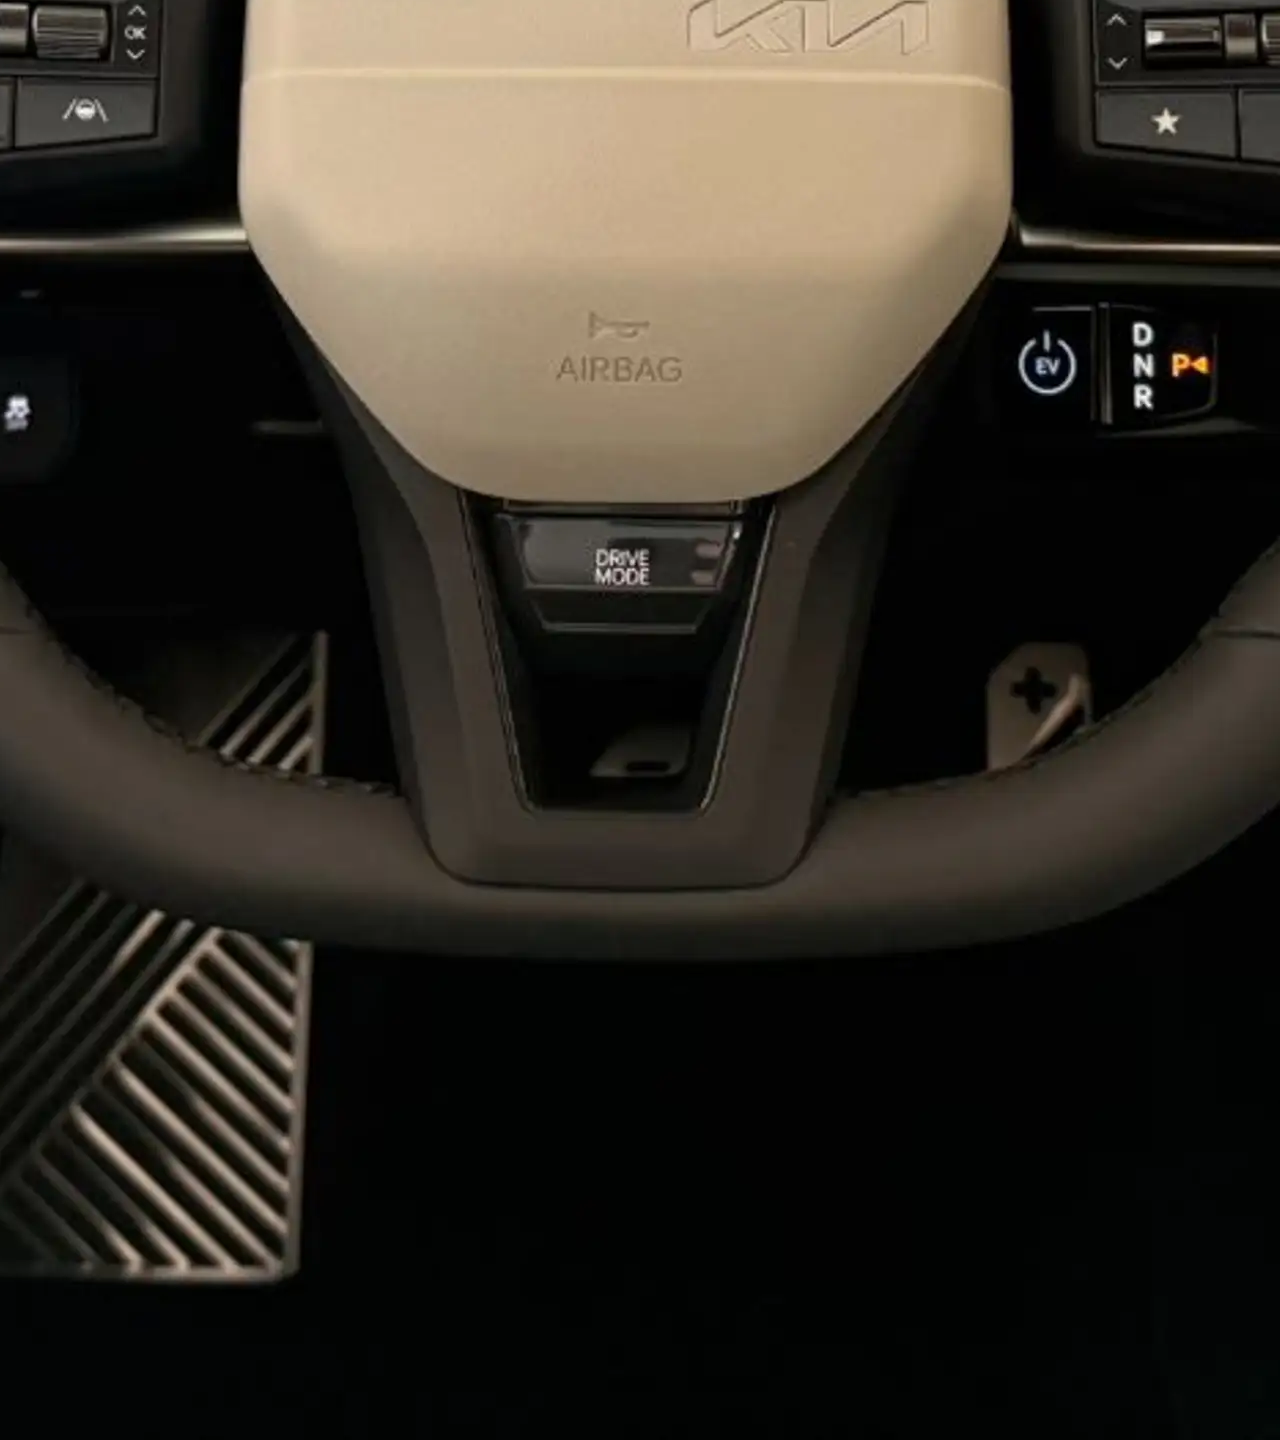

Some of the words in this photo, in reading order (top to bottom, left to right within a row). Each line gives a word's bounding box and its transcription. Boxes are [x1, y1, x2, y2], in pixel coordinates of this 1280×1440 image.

[124, 25, 146, 40] OK
[1132, 321, 1154, 347] D
[556, 356, 683, 384] AIRBAG
[1035, 356, 1061, 376] EV
[1133, 353, 1155, 378] N
[1171, 354, 1189, 378] P
[1133, 383, 1153, 409] R
[594, 547, 652, 567] DRIVE
[594, 567, 652, 587] MODE
